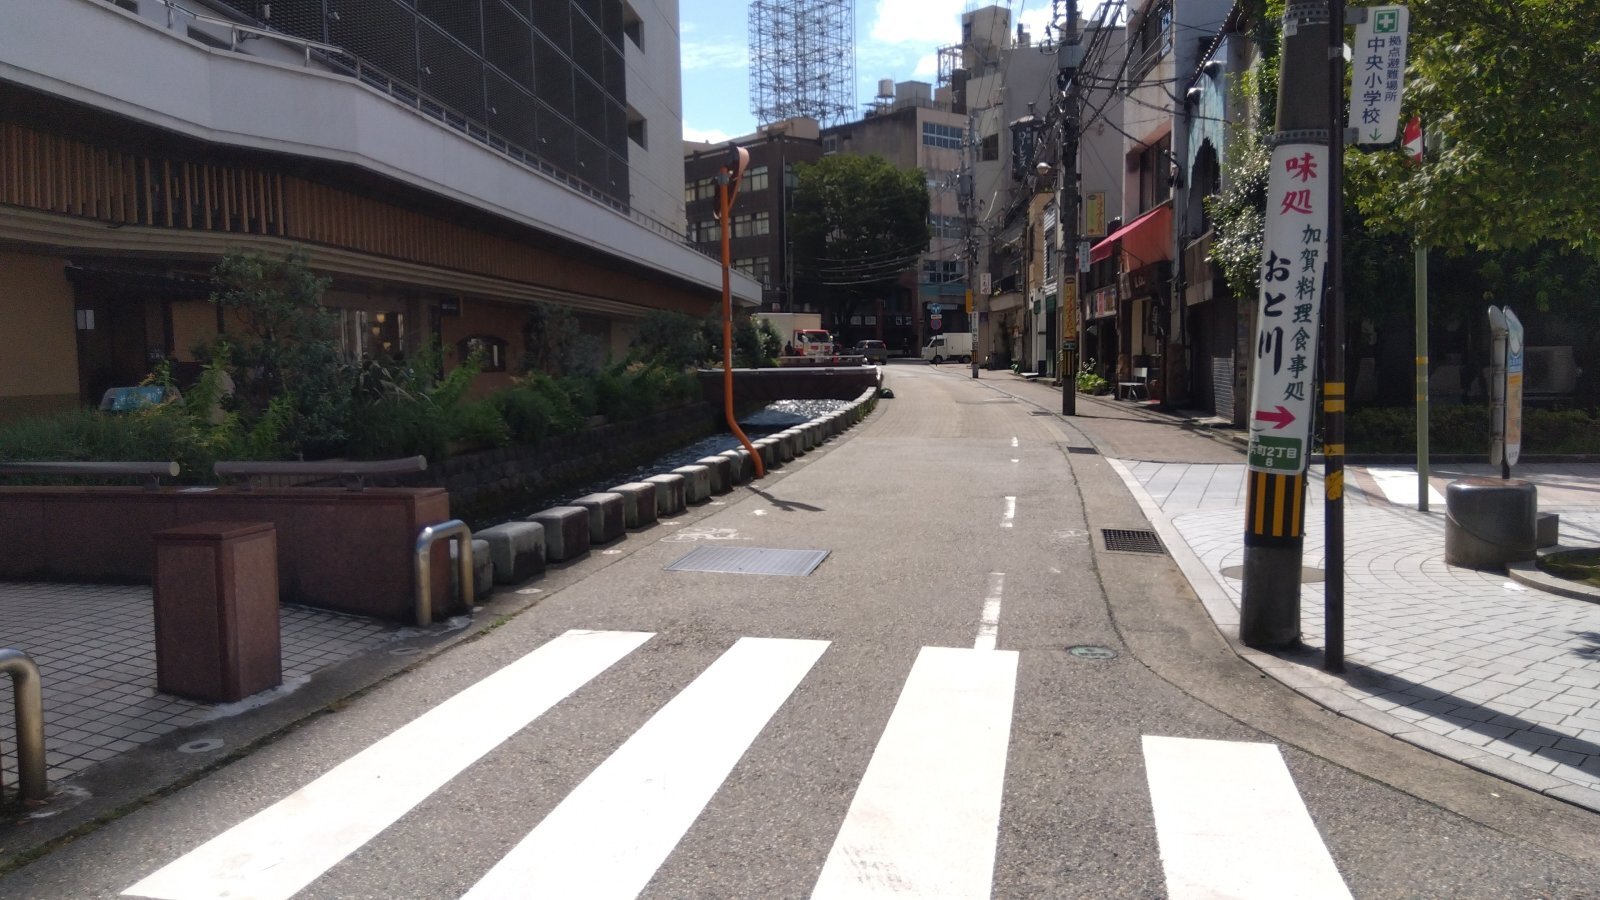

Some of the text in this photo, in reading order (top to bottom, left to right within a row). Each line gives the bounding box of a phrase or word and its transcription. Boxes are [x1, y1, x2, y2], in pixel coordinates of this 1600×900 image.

[1362, 36, 1385, 124] 中央小学校
[1384, 35, 1401, 102] 拠点避難場所
[1280, 152, 1318, 215] 味処
[1258, 250, 1291, 376] おと川
[1284, 224, 1321, 401] 加賀料理食事処
[1265, 457, 1273, 467] 8
